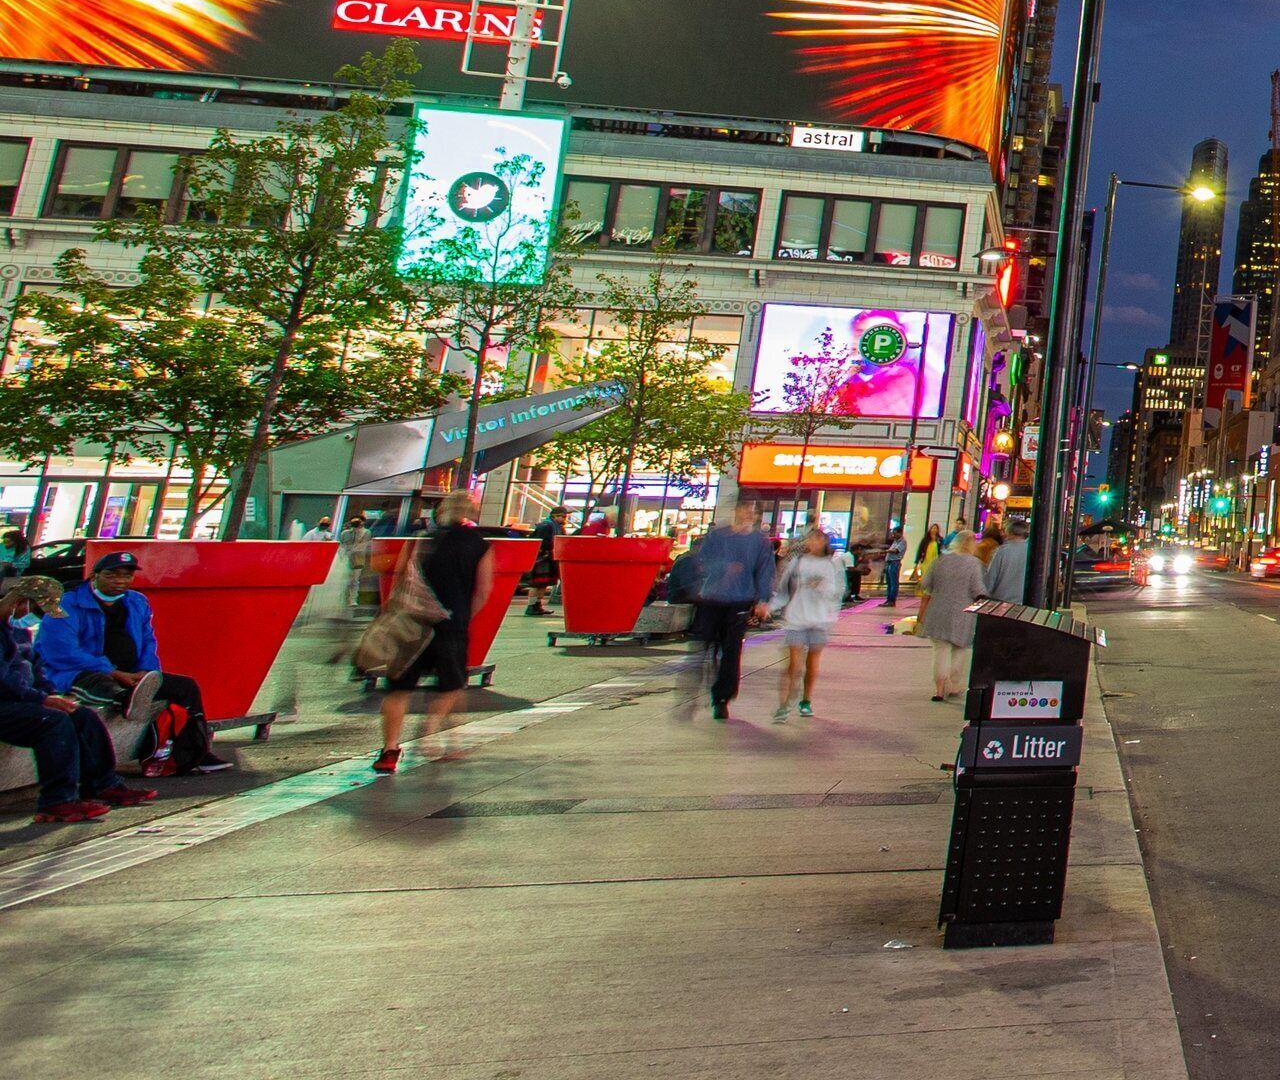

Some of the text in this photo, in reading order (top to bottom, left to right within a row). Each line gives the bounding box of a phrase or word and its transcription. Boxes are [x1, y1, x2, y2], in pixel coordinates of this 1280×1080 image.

[336, 0, 544, 41] CLARINS
[803, 132, 853, 146] astral
[440, 416, 506, 444] Vistor
[120, 553, 132, 562] S
[1012, 735, 1066, 759] Litter
